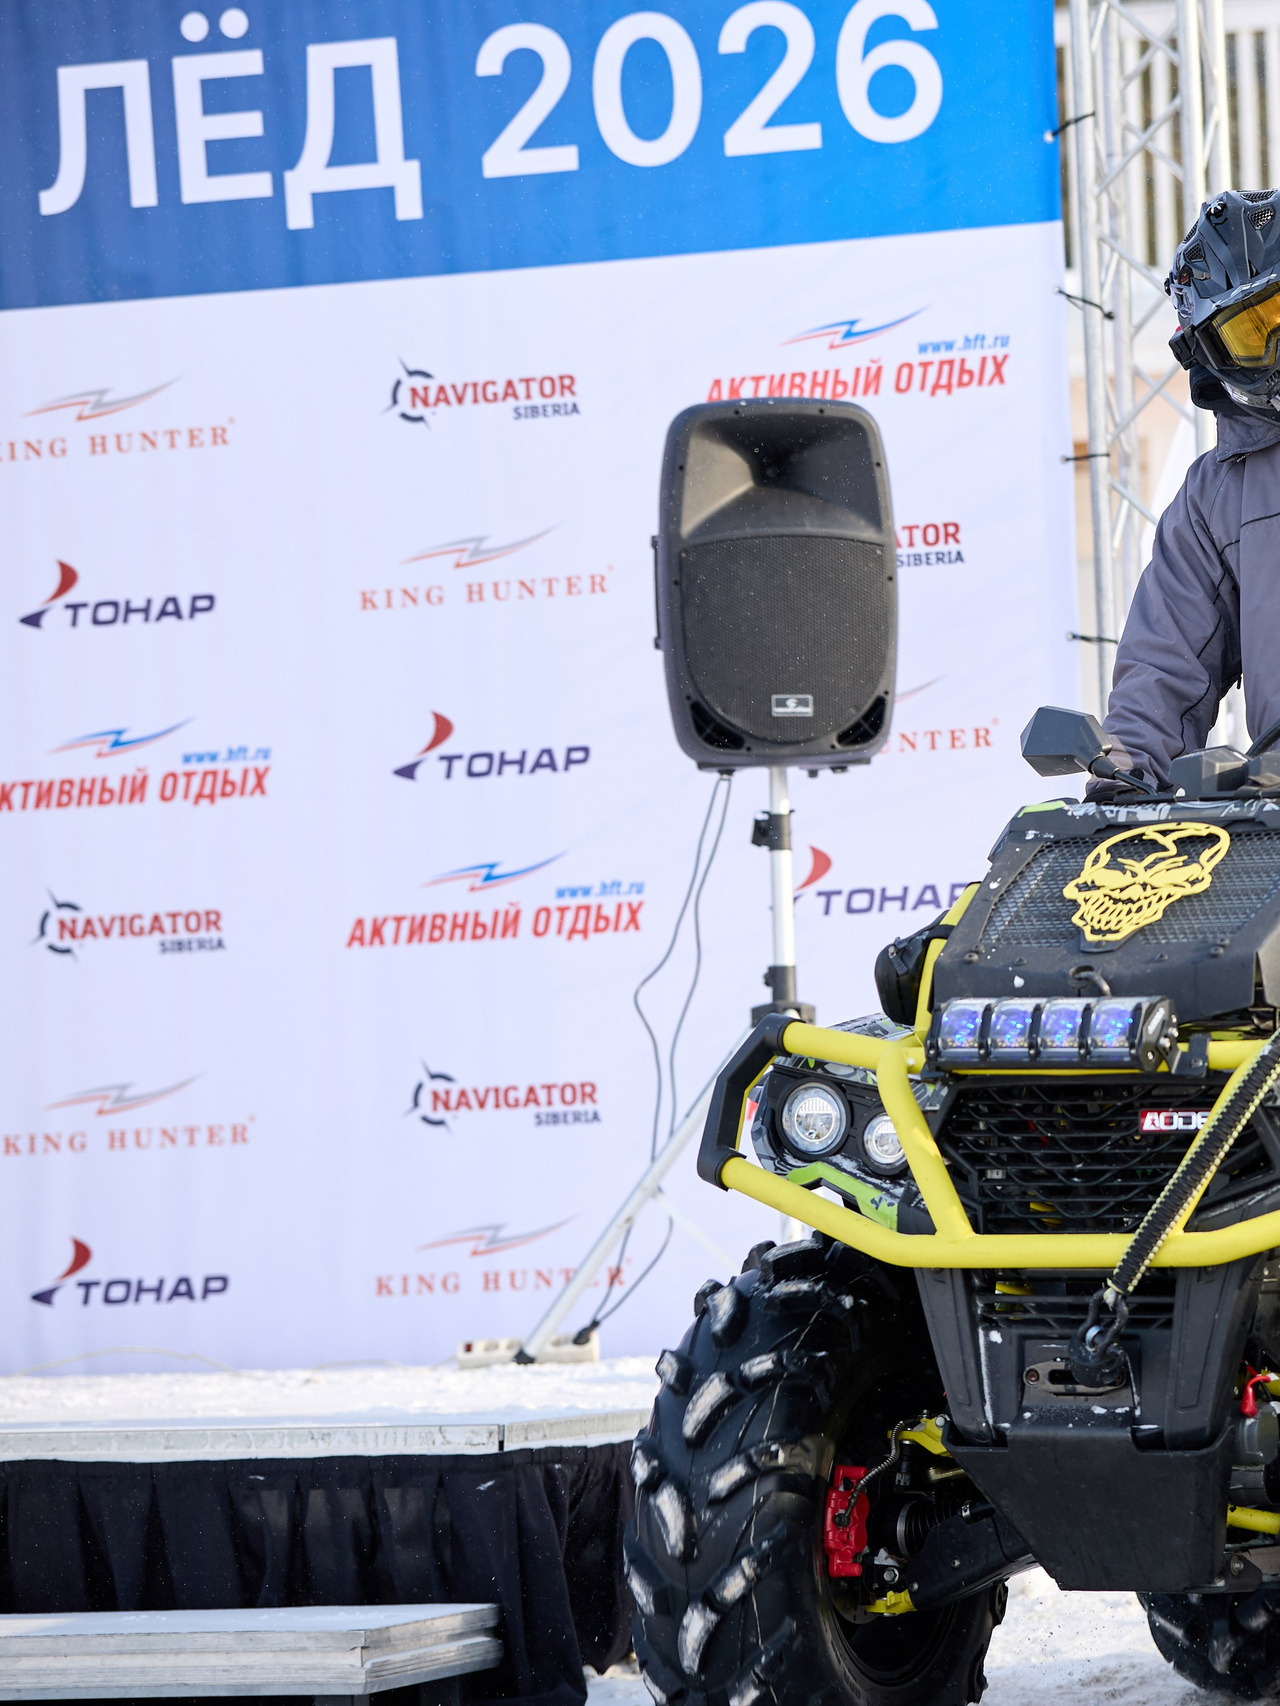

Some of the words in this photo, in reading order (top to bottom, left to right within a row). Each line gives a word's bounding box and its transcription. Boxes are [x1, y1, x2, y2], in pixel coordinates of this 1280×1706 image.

[39, 7, 423, 230] ЛЁД
[475, 0, 944, 178] 2026
[918, 333, 1009, 355] www.hft.ru
[410, 374, 577, 410] NAVIGATOR
[707, 358, 883, 402] АКТИВНЫЙ
[893, 353, 1009, 398] ОТДЫХ
[513, 401, 580, 420] SIBERIA
[0, 437, 68, 462] ING
[89, 426, 229, 456] HUNTER
[360, 586, 444, 612] KING
[467, 572, 608, 604] HUNTER
[65, 594, 216, 629] ТОНАР
[181, 746, 271, 765] www.hft.ru
[438, 746, 591, 780] ТОНАР
[159, 766, 271, 806] ОТДЫХ
[556, 880, 645, 899] www.hft.ru
[58, 910, 223, 941] NAVIGATOR
[346, 902, 521, 949] АКТИВНЫЙ
[532, 900, 644, 942] ОТДЫХ
[159, 937, 225, 954] SIBERIA
[431, 1082, 597, 1113] NAVIGATOR
[534, 1110, 601, 1127] SIBERIA
[4, 1133, 87, 1156] KING
[108, 1122, 249, 1151] HUNTER
[76, 1275, 229, 1307] ТОНАР
[376, 1274, 460, 1297] KING
[483, 1265, 625, 1292] HUNTR
